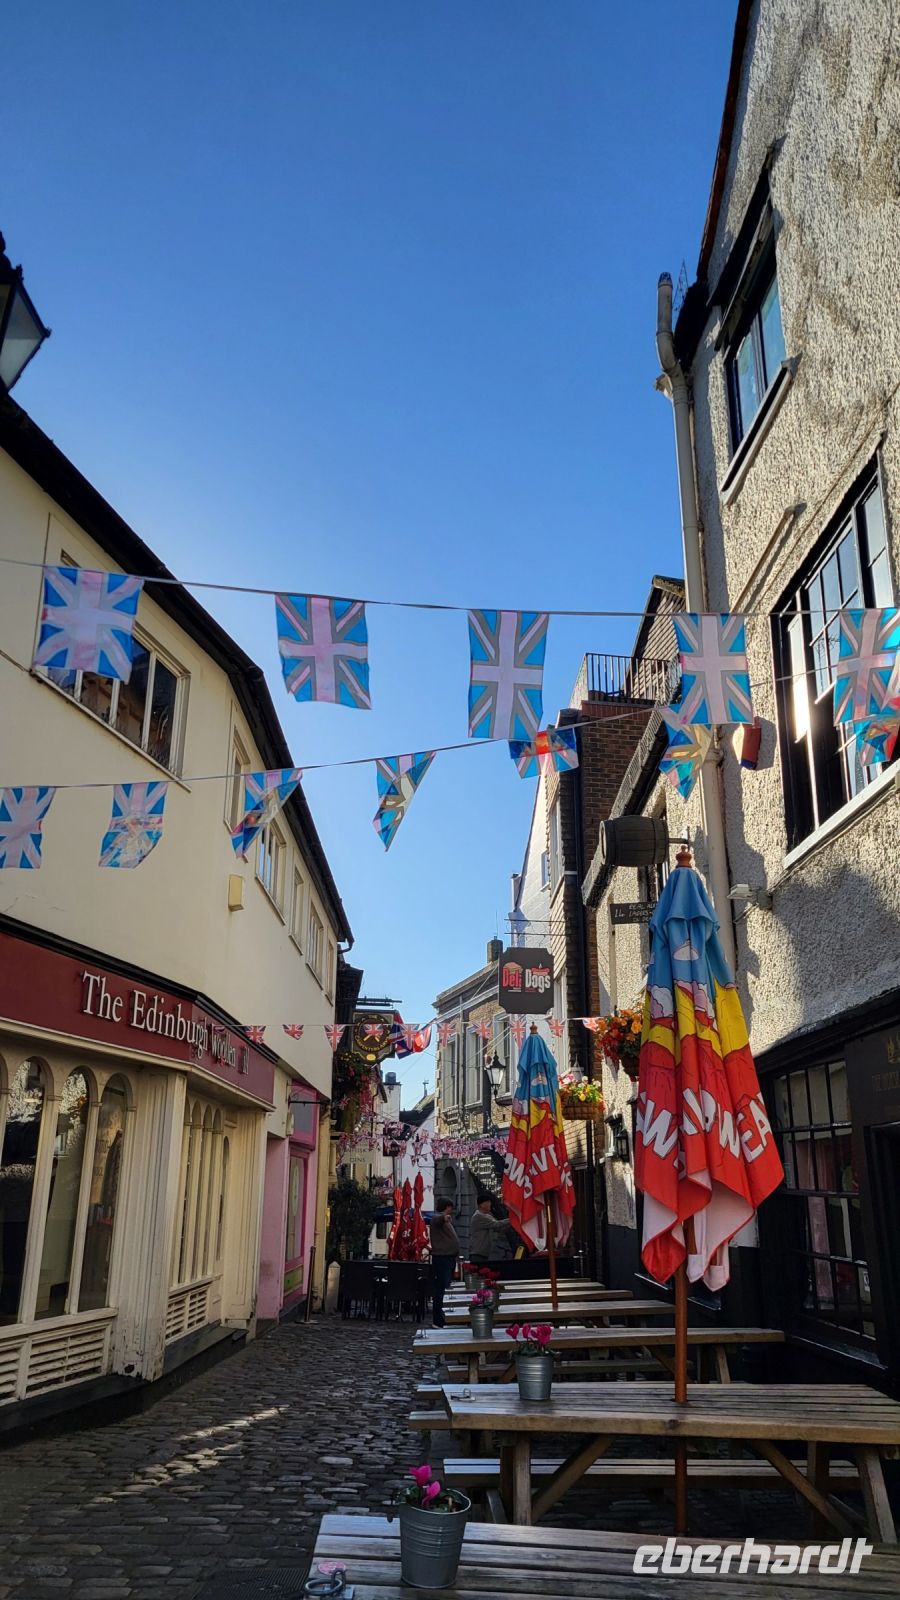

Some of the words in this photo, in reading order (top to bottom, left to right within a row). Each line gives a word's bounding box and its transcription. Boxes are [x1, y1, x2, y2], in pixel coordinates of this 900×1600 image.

[502, 967, 522, 988] Deli
[525, 968, 551, 993] Dogs
[82, 970, 123, 1022] The
[131, 990, 208, 1059] Edinburgh
[212, 1023, 236, 1067] Woollen
